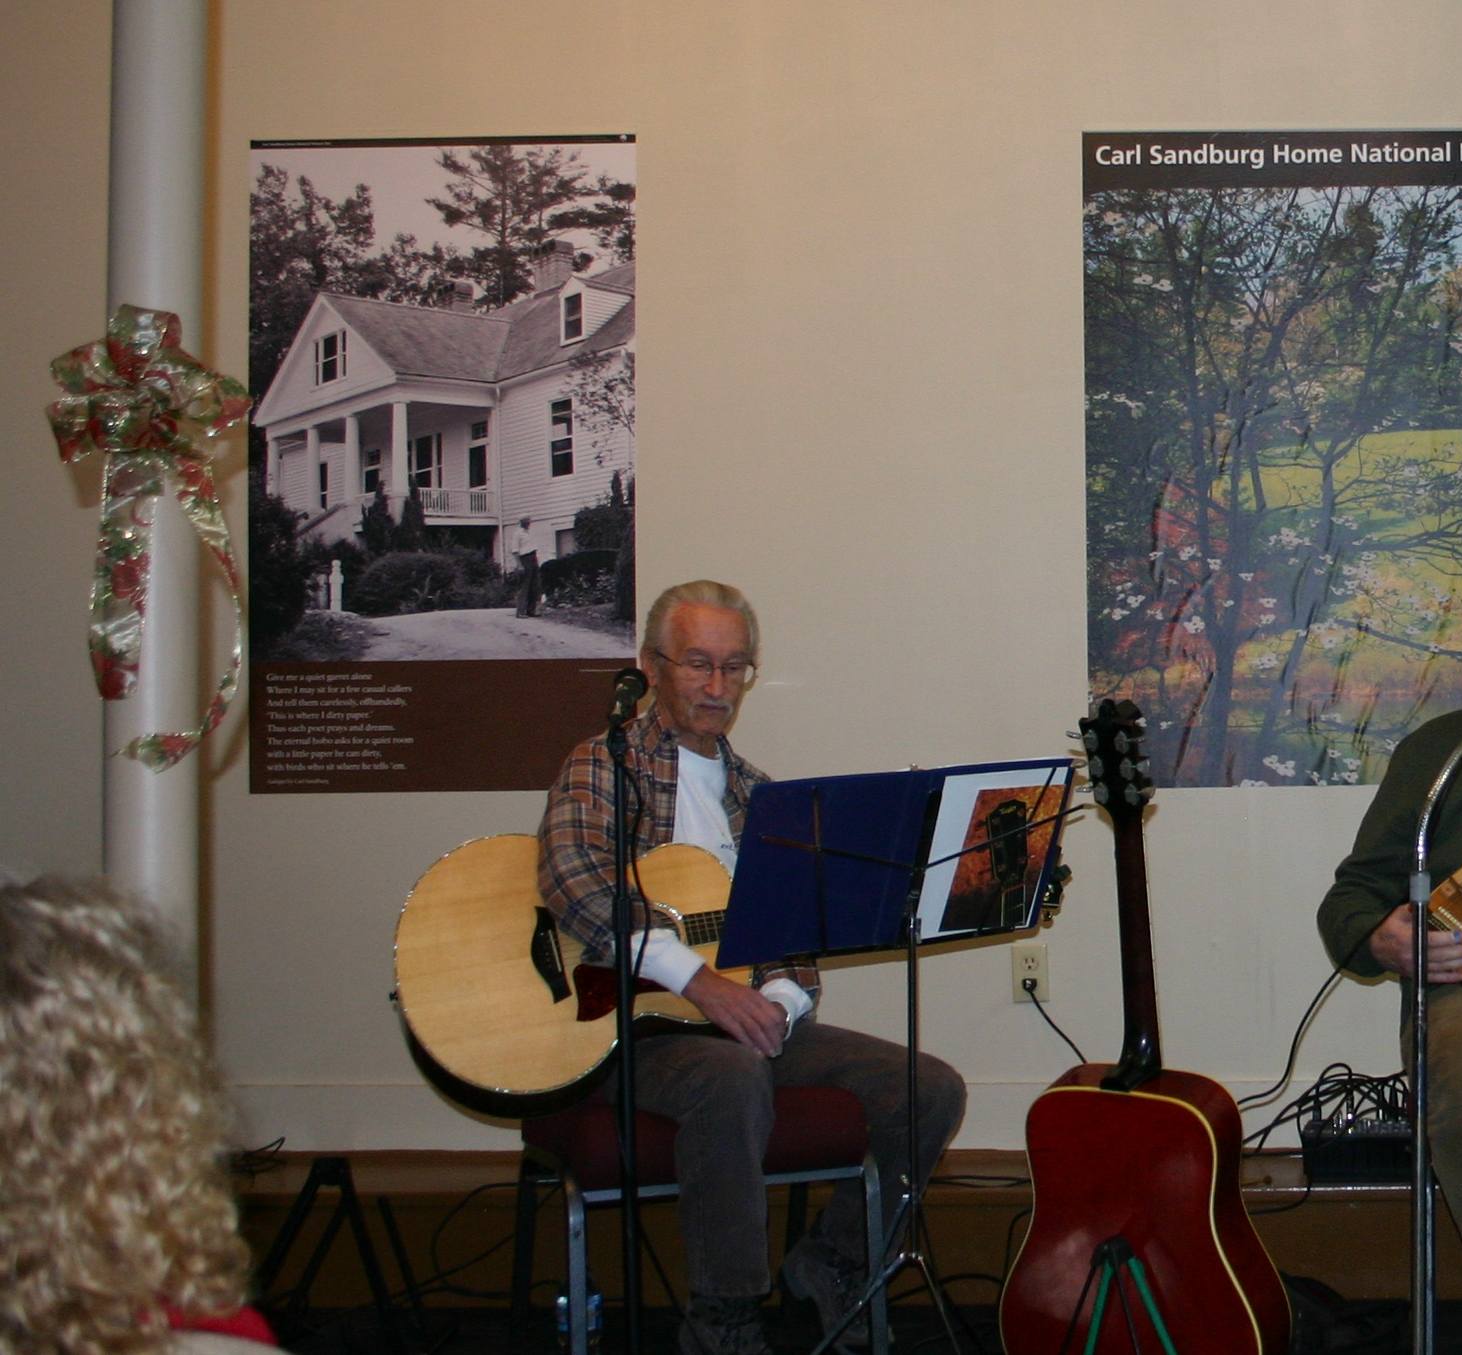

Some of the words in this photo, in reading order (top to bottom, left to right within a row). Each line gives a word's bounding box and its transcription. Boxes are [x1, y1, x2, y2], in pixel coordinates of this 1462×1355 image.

[1095, 144, 1141, 165] Carl
[1150, 144, 1265, 169] Sandburg
[1273, 144, 1343, 163] Home
[1351, 142, 1451, 163] National
[266, 673, 284, 681] Give
[305, 673, 325, 683] quiet
[266, 686, 292, 694] Where
[299, 687, 315, 695] may
[327, 685, 339, 693] for
[346, 685, 360, 693] few
[362, 685, 385, 693] casual
[387, 685, 413, 693] callers
[296, 711, 320, 719] where
[326, 711, 344, 720] dirty
[267, 724, 286, 732] Thus
[288, 724, 306, 732] each
[308, 725, 325, 733] poet
[267, 737, 283, 745] The
[352, 736, 364, 744] for
[371, 736, 391, 746] quiet
[267, 750, 284, 758] with
[292, 749, 309, 758] little
[334, 749, 344, 757] he
[267, 763, 284, 771] with
[362, 762, 372, 770] he
